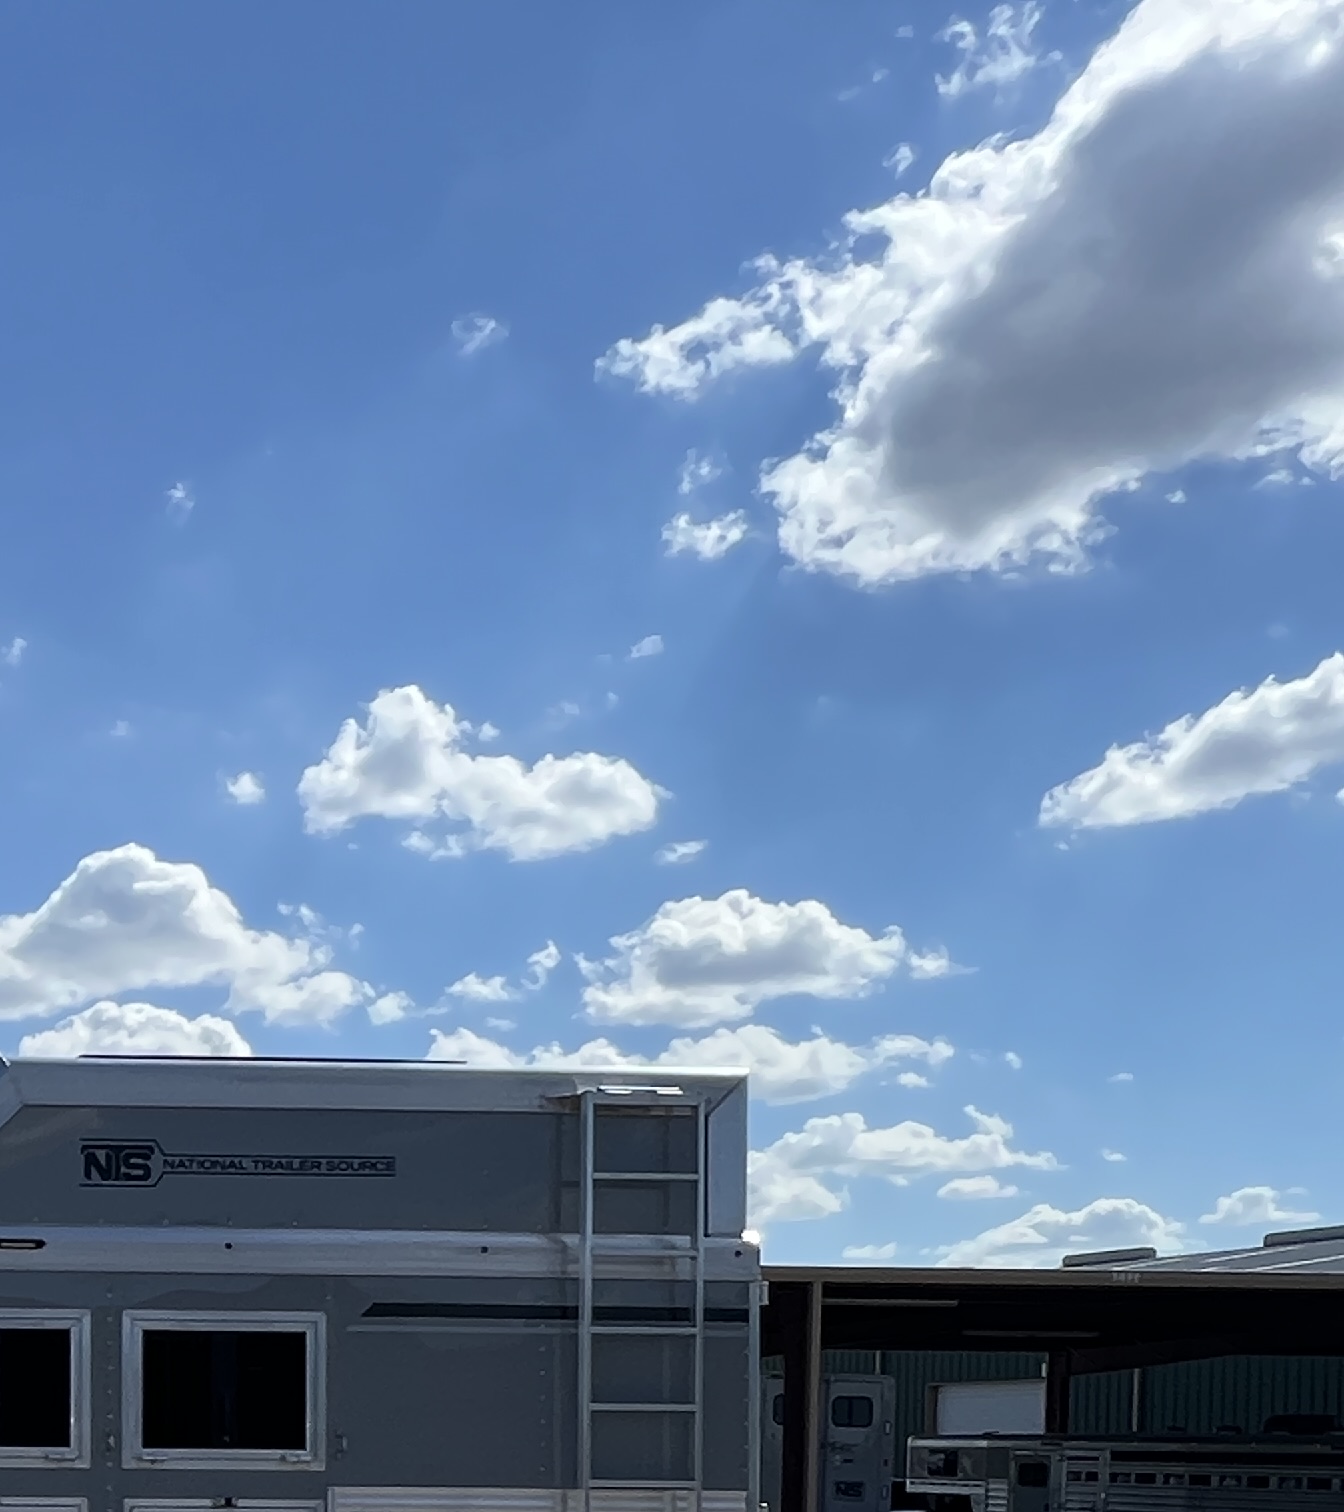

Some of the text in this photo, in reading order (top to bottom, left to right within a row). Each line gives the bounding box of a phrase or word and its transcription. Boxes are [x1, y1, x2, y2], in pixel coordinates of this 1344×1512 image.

[80, 1144, 156, 1182] NTS
[163, 1158, 396, 1173] NATIONAL TRAILER SOURCE
